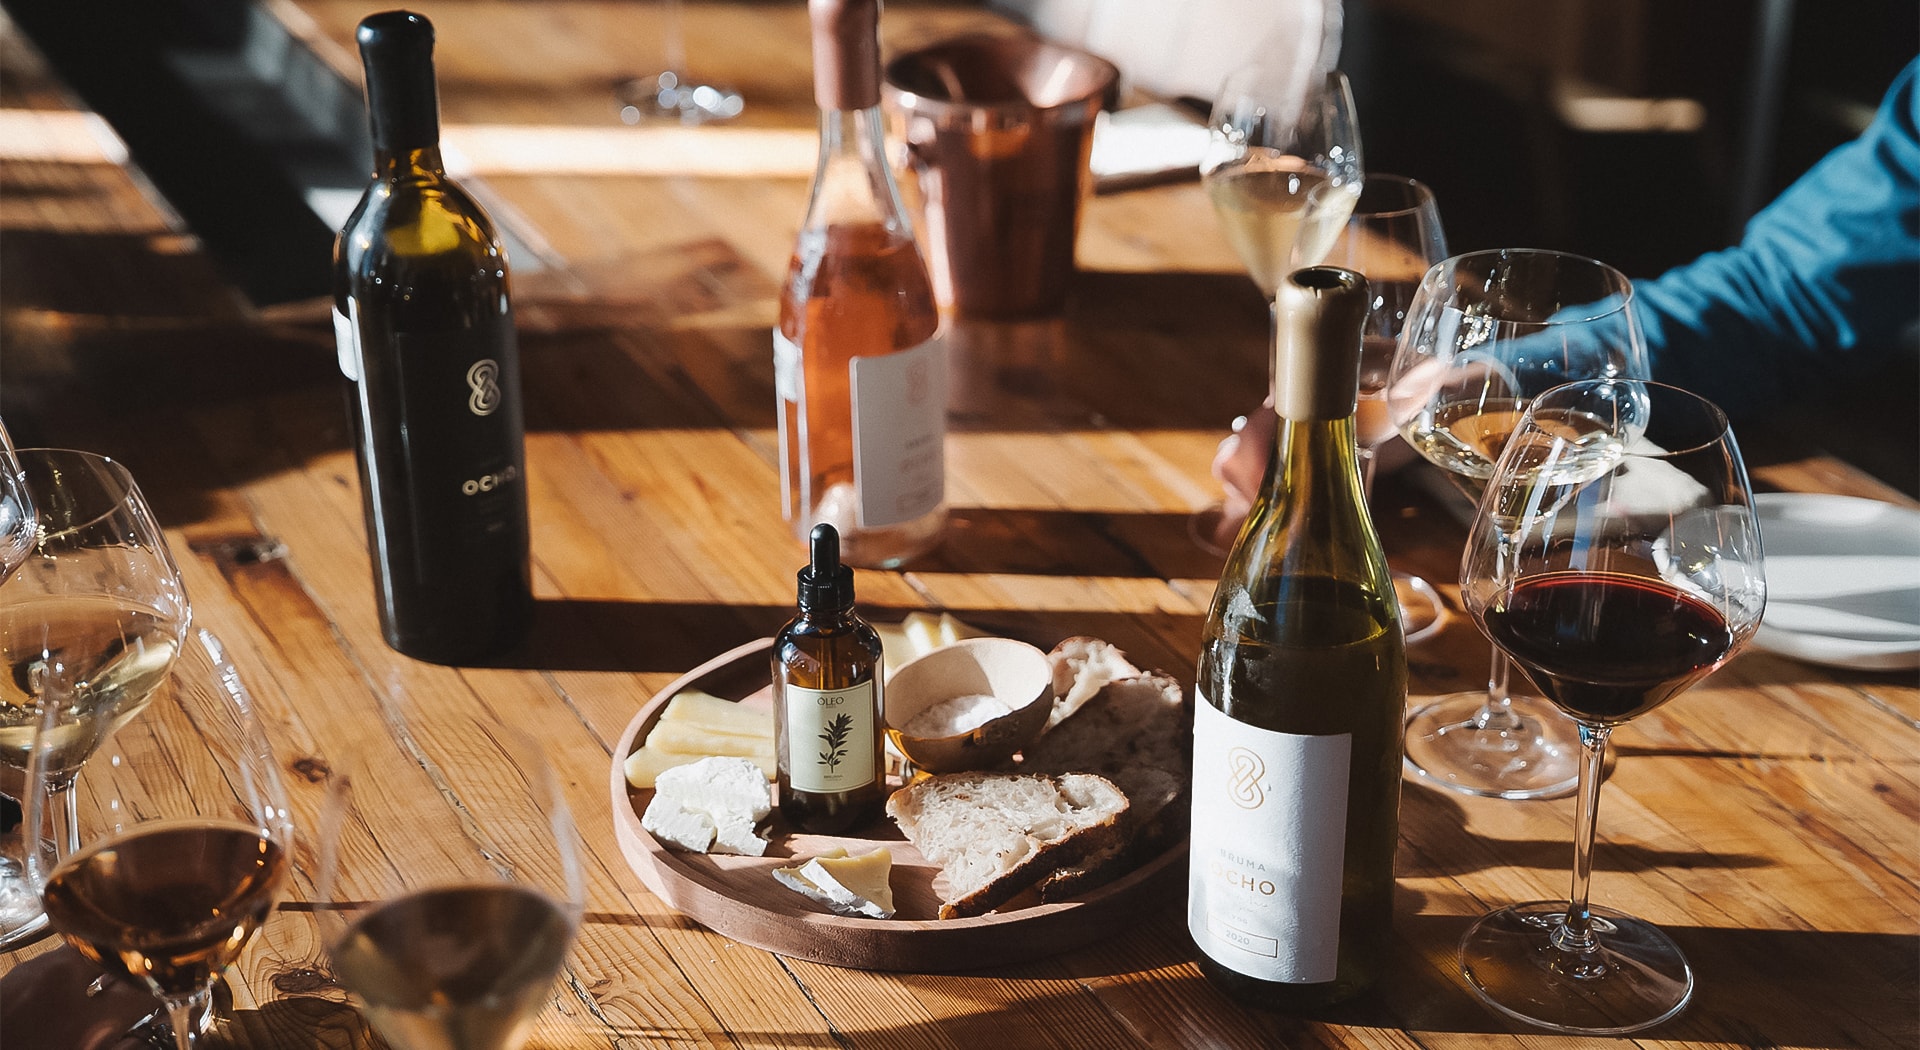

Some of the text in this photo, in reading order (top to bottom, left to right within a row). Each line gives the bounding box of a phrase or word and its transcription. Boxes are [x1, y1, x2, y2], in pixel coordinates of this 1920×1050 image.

[1220, 848, 1266, 872] BRUMA
[1210, 862, 1276, 896] OCHO
[1225, 929, 1250, 946] 2020
